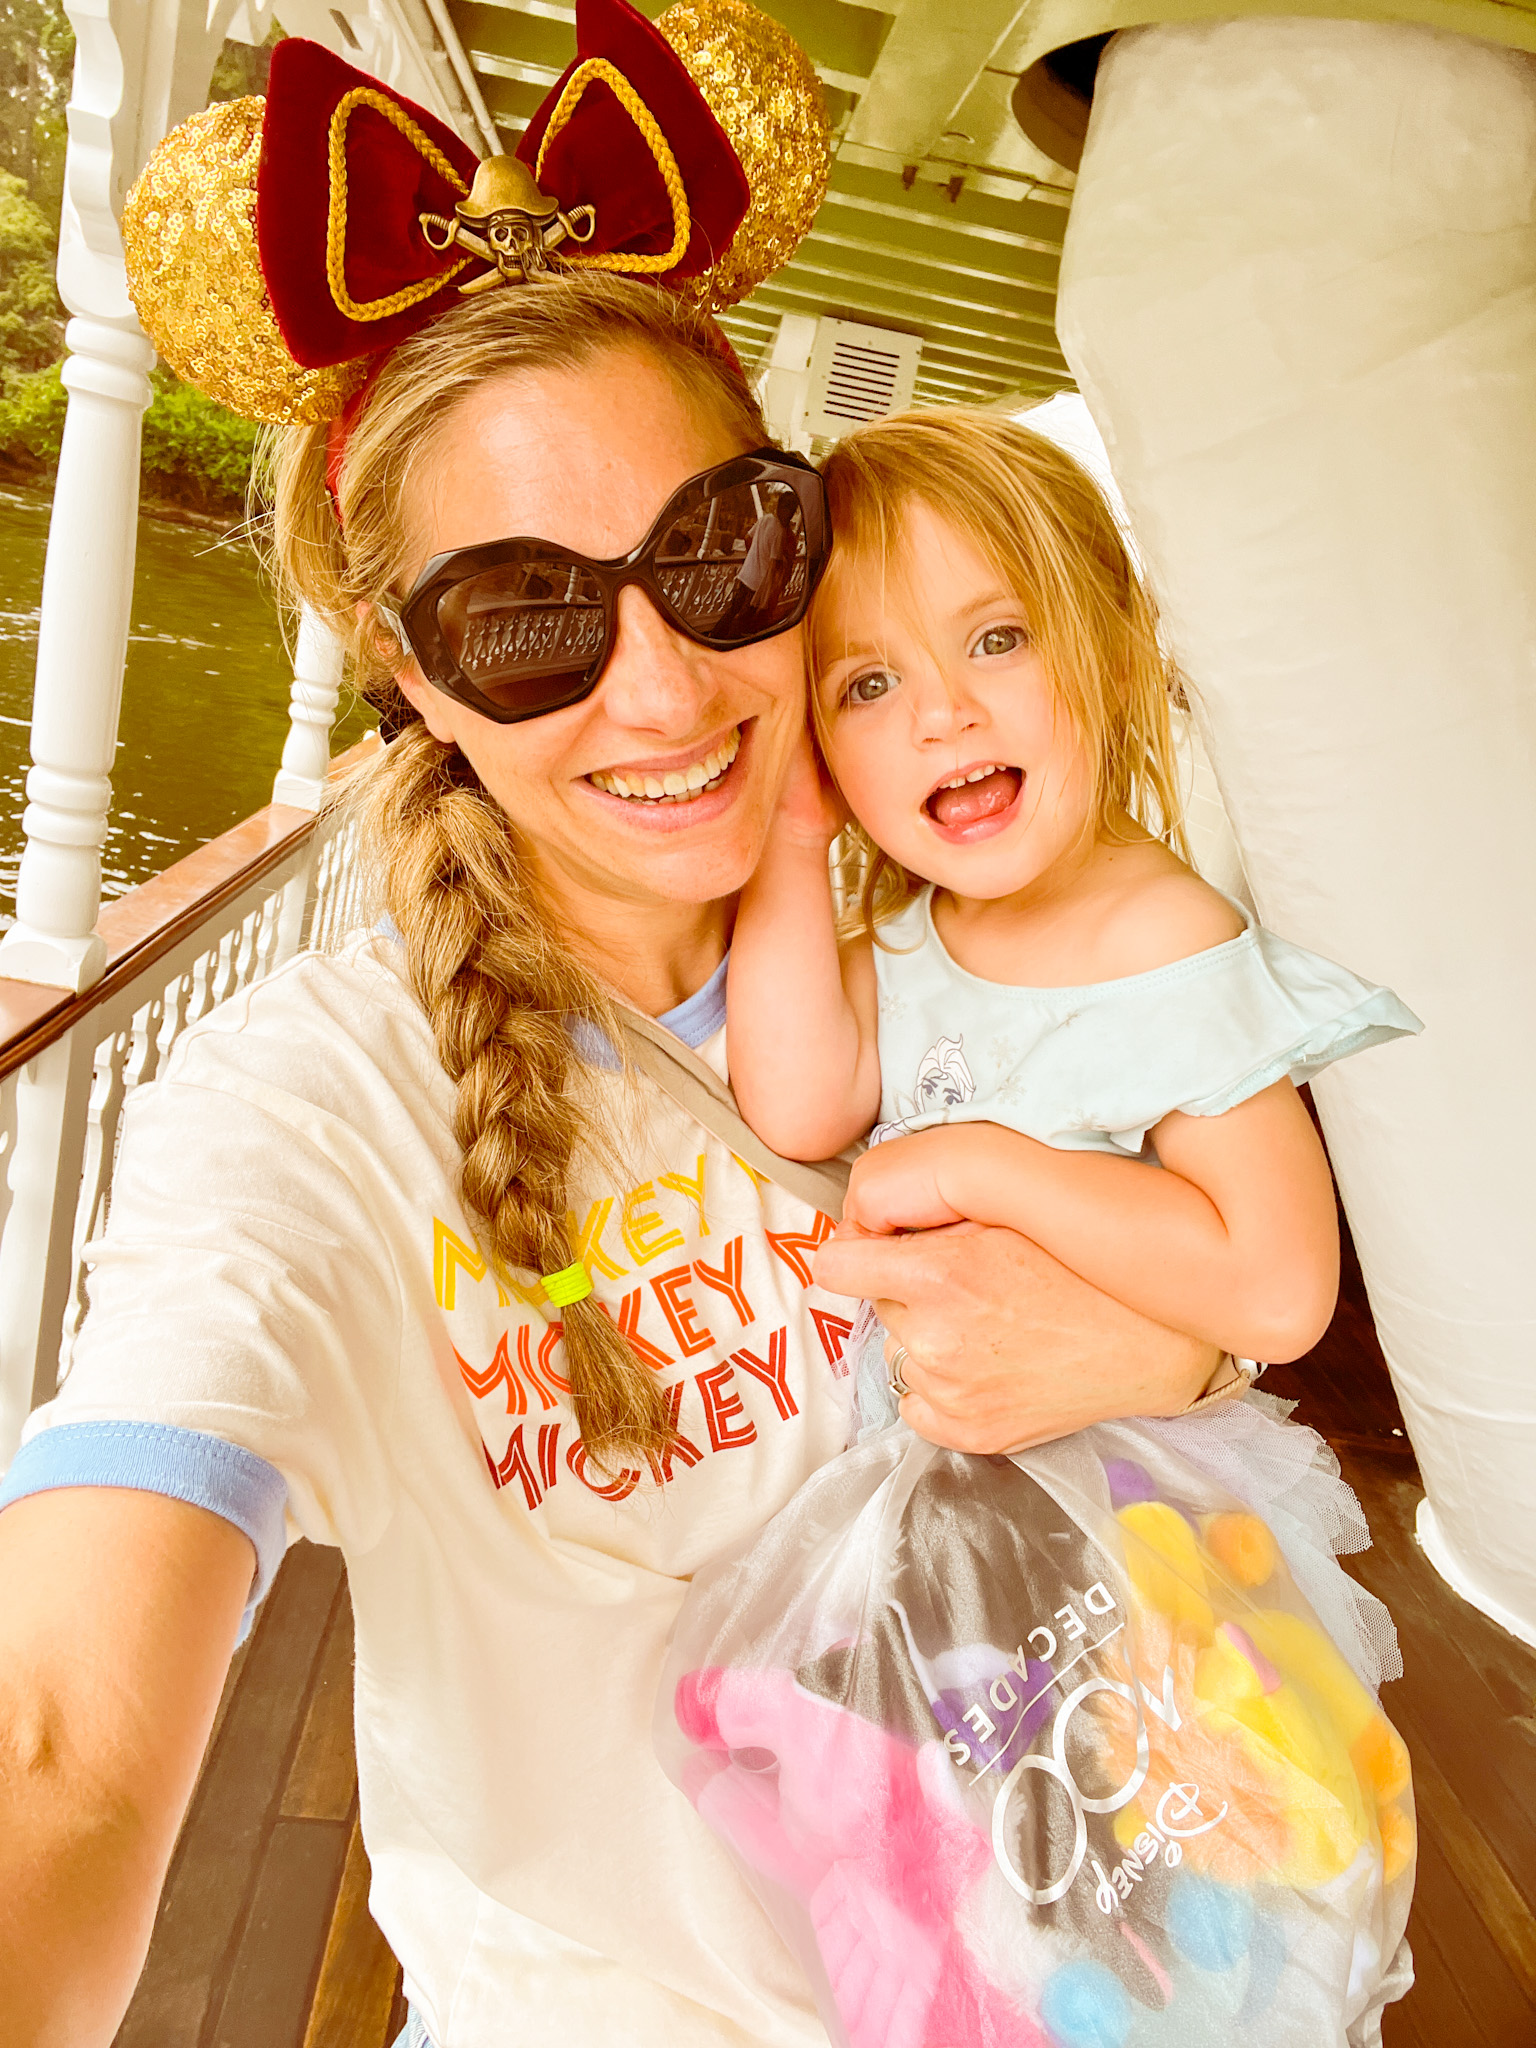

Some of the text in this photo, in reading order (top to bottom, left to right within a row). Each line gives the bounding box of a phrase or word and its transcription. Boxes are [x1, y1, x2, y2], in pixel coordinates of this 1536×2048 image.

[433, 1154, 710, 1311] MKEY
[943, 1581, 1117, 1766] DECADES
[991, 1644, 1183, 1905] 100
